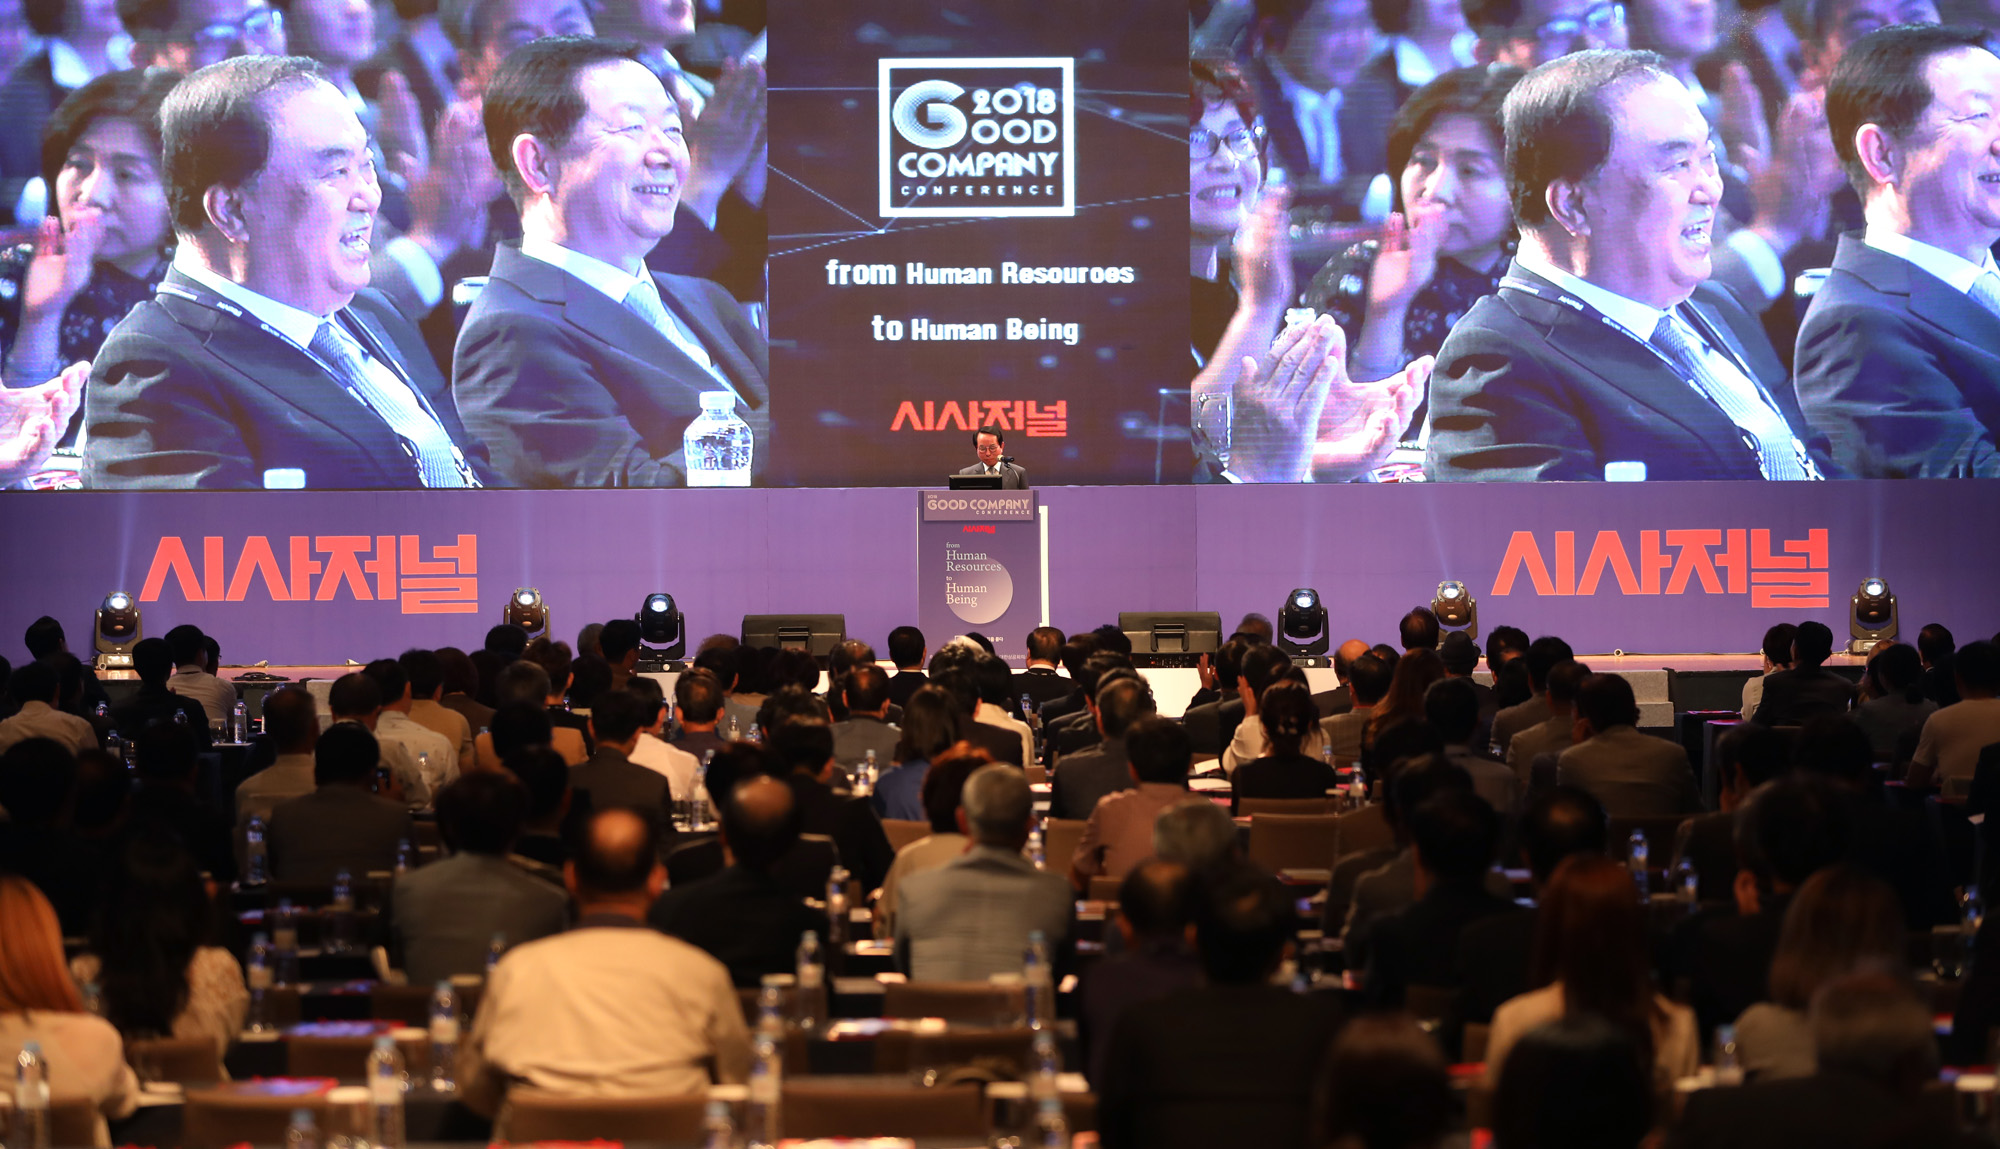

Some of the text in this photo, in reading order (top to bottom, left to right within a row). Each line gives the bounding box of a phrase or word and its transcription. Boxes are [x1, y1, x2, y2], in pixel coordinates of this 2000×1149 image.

[972, 86, 1056, 115] 2018
[898, 151, 1059, 178] COMPANY
[901, 185, 1055, 196] CONFERENCE
[825, 259, 897, 285] from
[906, 262, 992, 285] Human
[871, 314, 1079, 345] to Human Being
[890, 400, 1067, 437] 시사저널
[927, 499, 1029, 511] GOOD COMPANY
[946, 541, 960, 549] from
[946, 549, 987, 560] Human
[139, 534, 478, 614] 시사저널
[946, 560, 1002, 572] Resources
[1490, 528, 1830, 609] 시사저널
[946, 582, 987, 593] Human
[946, 593, 978, 607] Being
